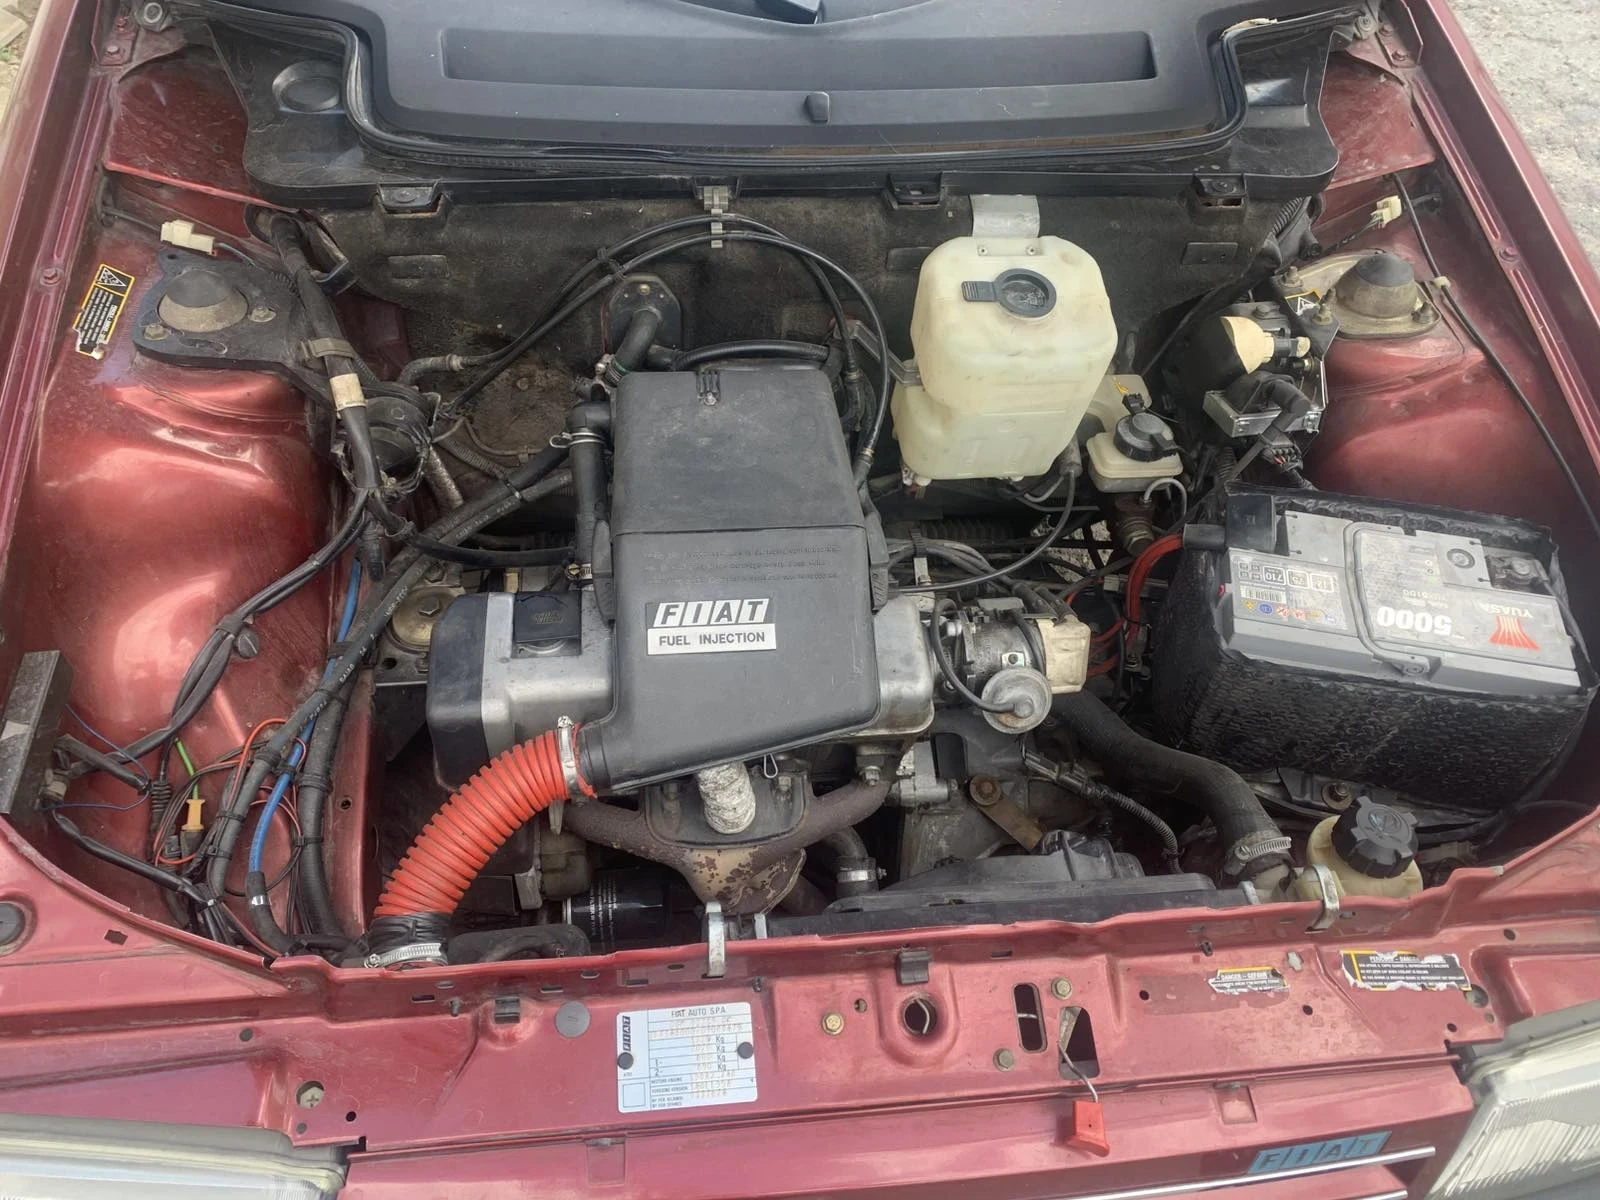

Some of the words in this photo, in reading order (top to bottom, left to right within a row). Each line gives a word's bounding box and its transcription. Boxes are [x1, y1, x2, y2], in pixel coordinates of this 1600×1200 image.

[656, 600, 766, 627] FIAT
[1478, 600, 1534, 618] YUASA
[1376, 606, 1452, 636] 5000
[659, 634, 691, 646] FUEL
[699, 632, 765, 645] INJECTION
[671, 1009, 686, 1018] FIAT
[688, 1008, 707, 1016] AUTO
[622, 1016, 631, 1051] FIAT
[716, 1035, 725, 1044] Kg
[716, 1044, 726, 1053] Kg
[717, 1053, 726, 1062] Kg
[717, 1063, 727, 1072] Kg
[1256, 1135, 1384, 1171] FIAT
